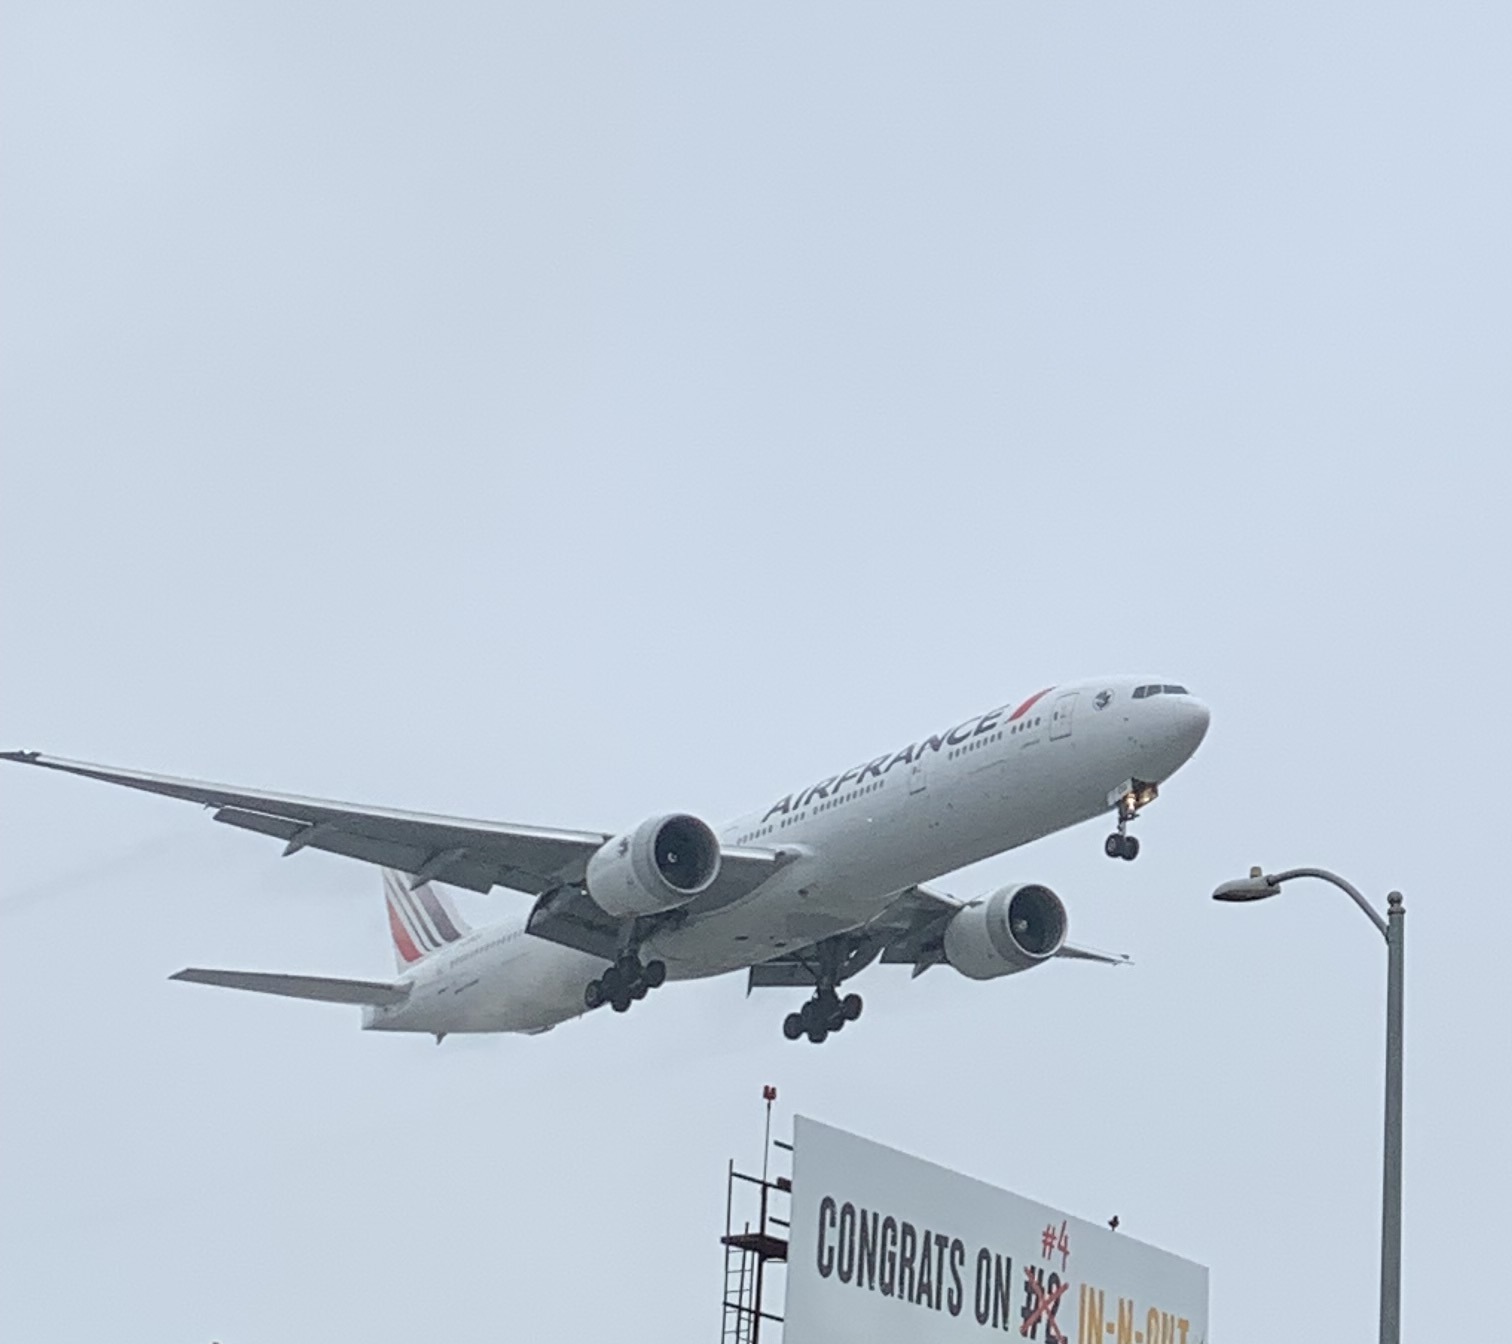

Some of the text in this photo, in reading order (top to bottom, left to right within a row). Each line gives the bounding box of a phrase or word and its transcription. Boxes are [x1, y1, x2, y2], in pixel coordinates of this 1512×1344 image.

[816, 1196, 965, 1318] CONGRATS
[974, 1247, 1013, 1332] ON
[1041, 1220, 1070, 1273] #4
